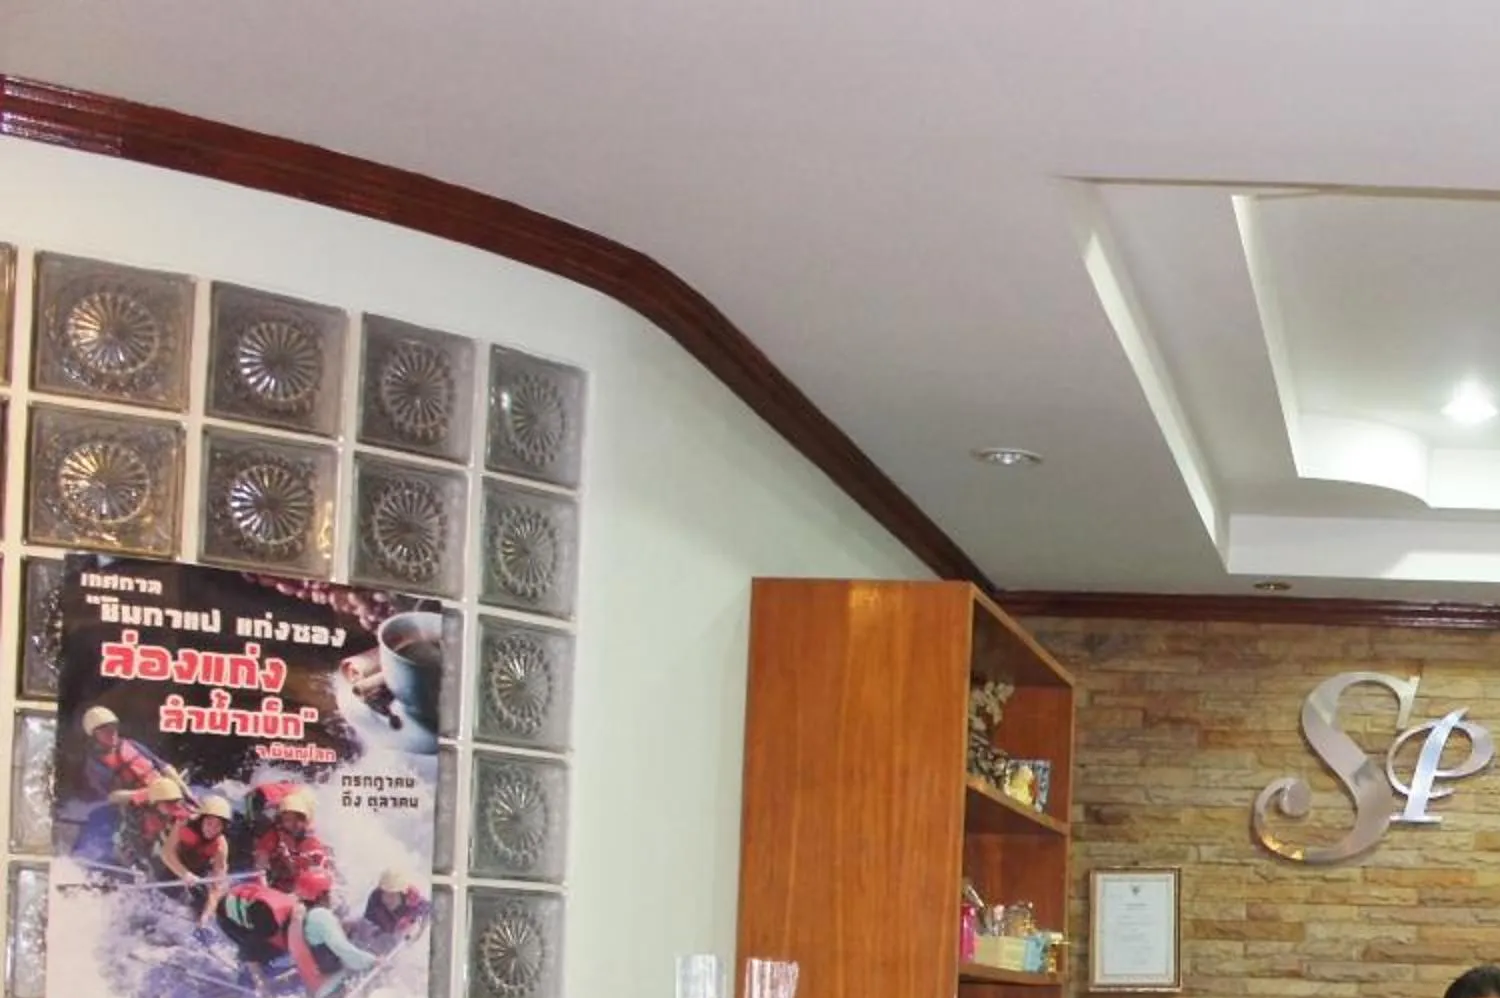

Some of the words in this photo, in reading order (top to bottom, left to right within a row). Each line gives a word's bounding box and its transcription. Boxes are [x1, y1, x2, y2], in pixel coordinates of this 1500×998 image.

[80, 572, 163, 595] เทศกาล
[101, 629, 287, 693] ล่องแก่ง
[1254, 671, 1494, 862] SP
[341, 775, 415, 791] กรกฎาคม
[367, 796, 419, 813] ตุลาคม
